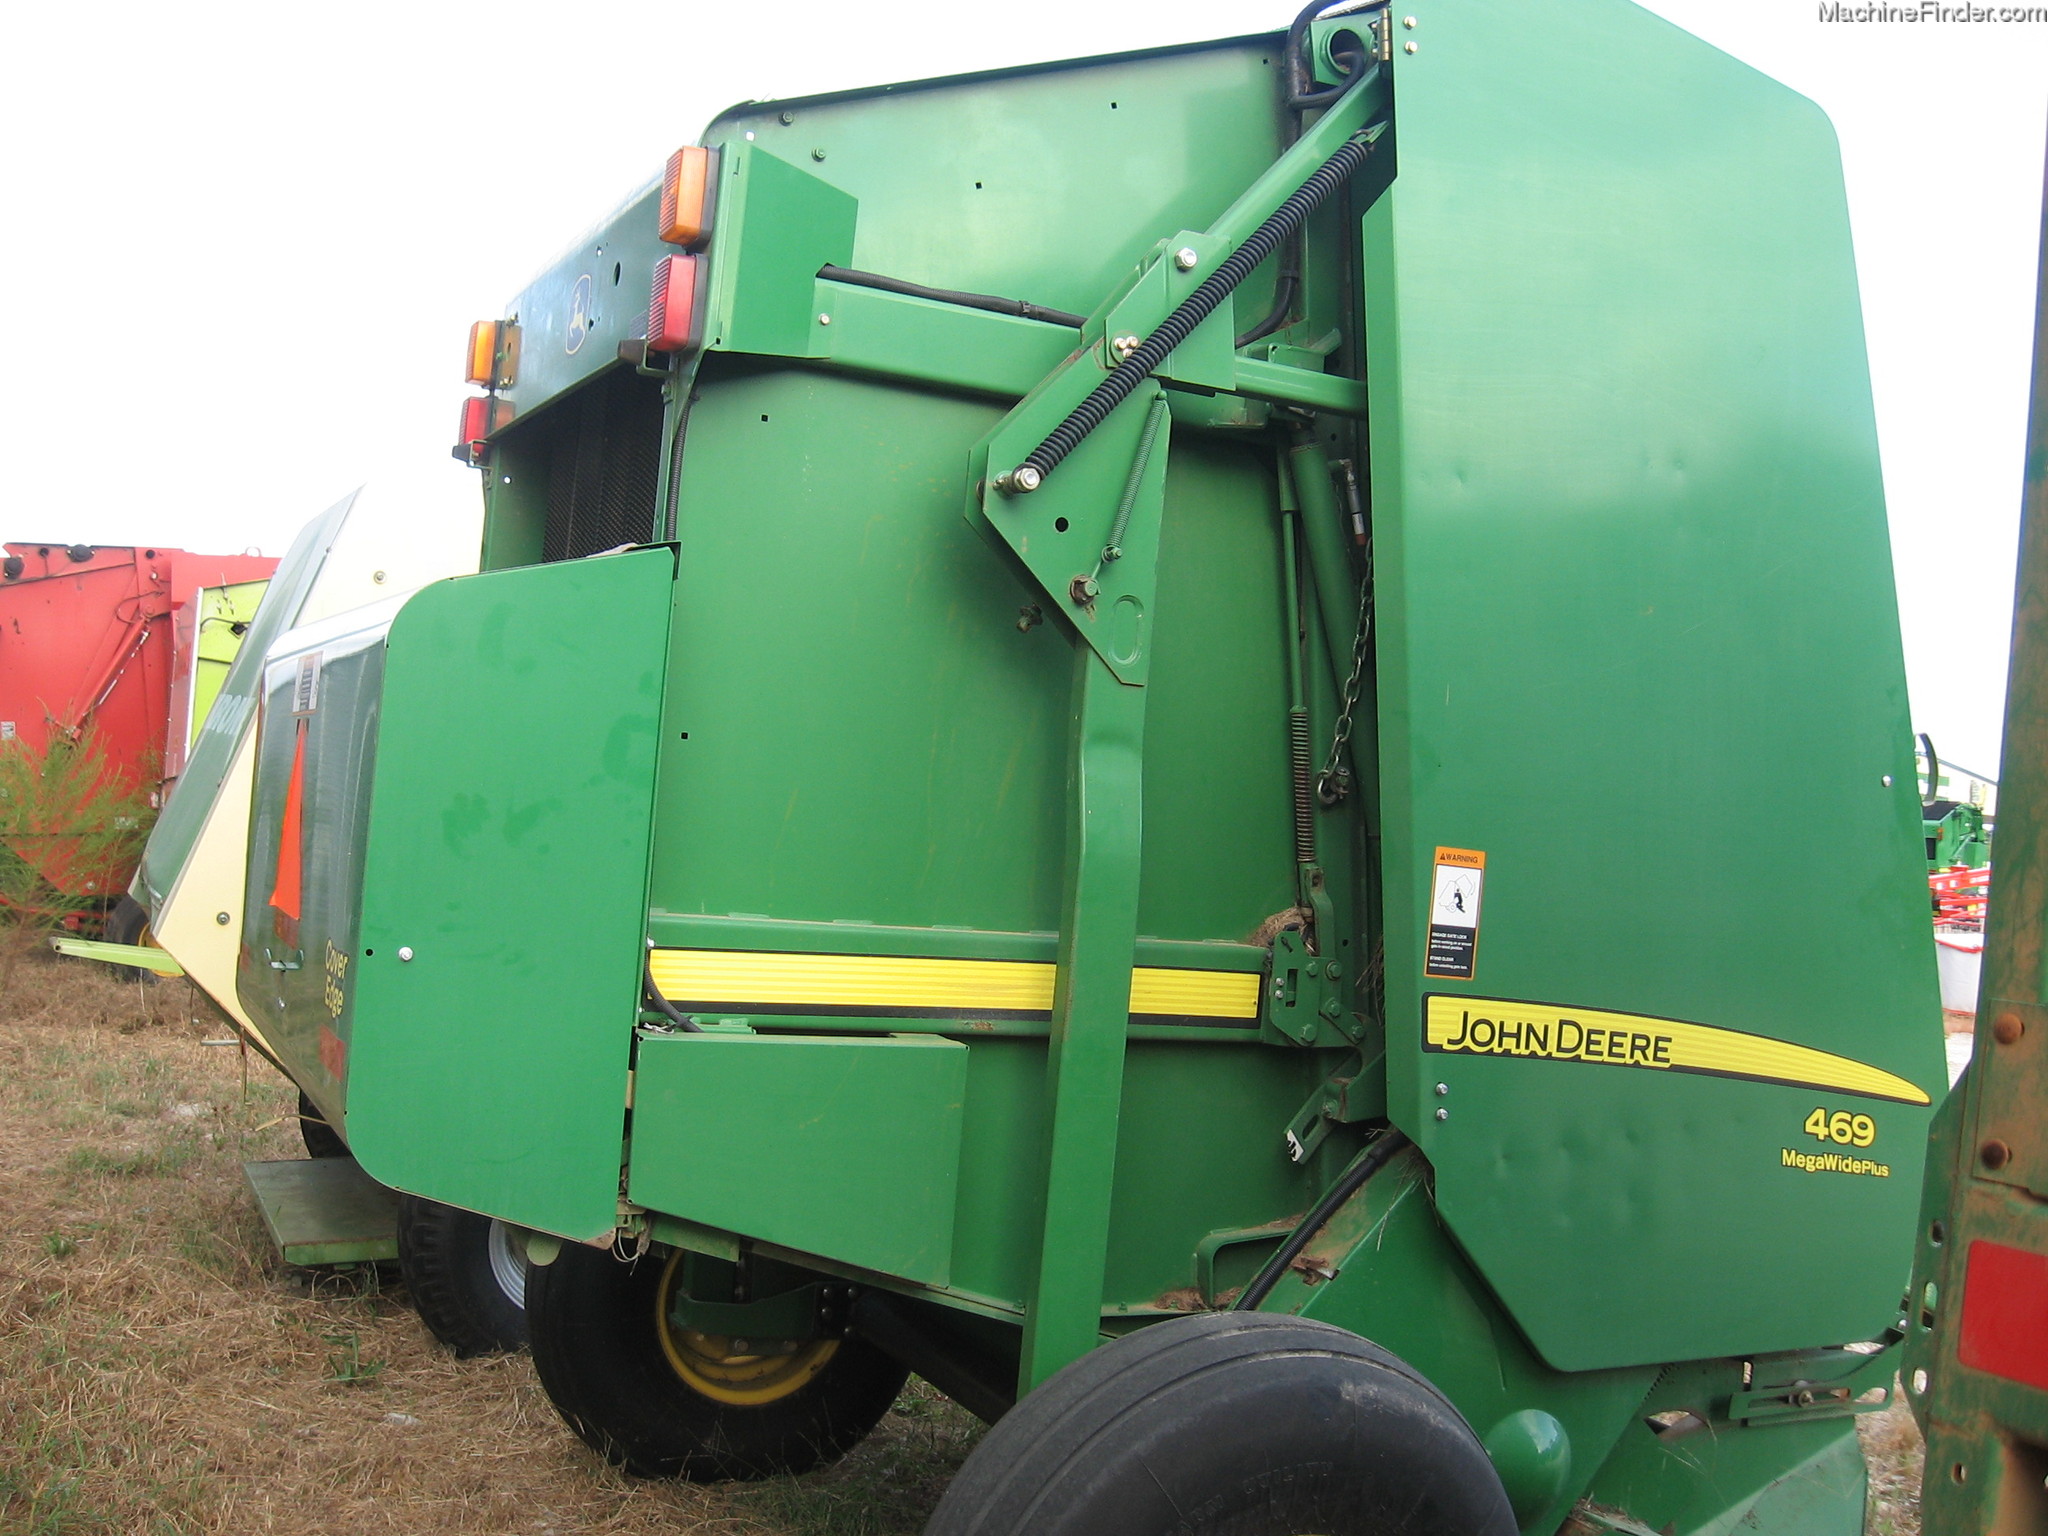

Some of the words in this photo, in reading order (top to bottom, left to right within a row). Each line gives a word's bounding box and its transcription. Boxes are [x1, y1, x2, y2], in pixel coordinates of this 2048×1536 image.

[1446, 853, 1478, 863] WARNING
[326, 939, 348, 979] Cover
[325, 975, 344, 1018] Edge
[1447, 1011, 1549, 1052] JOHN
[1556, 1019, 1673, 1063] DEERE
[1804, 1107, 1876, 1147] 469
[1781, 1148, 1889, 1177] MegaWidePlus
